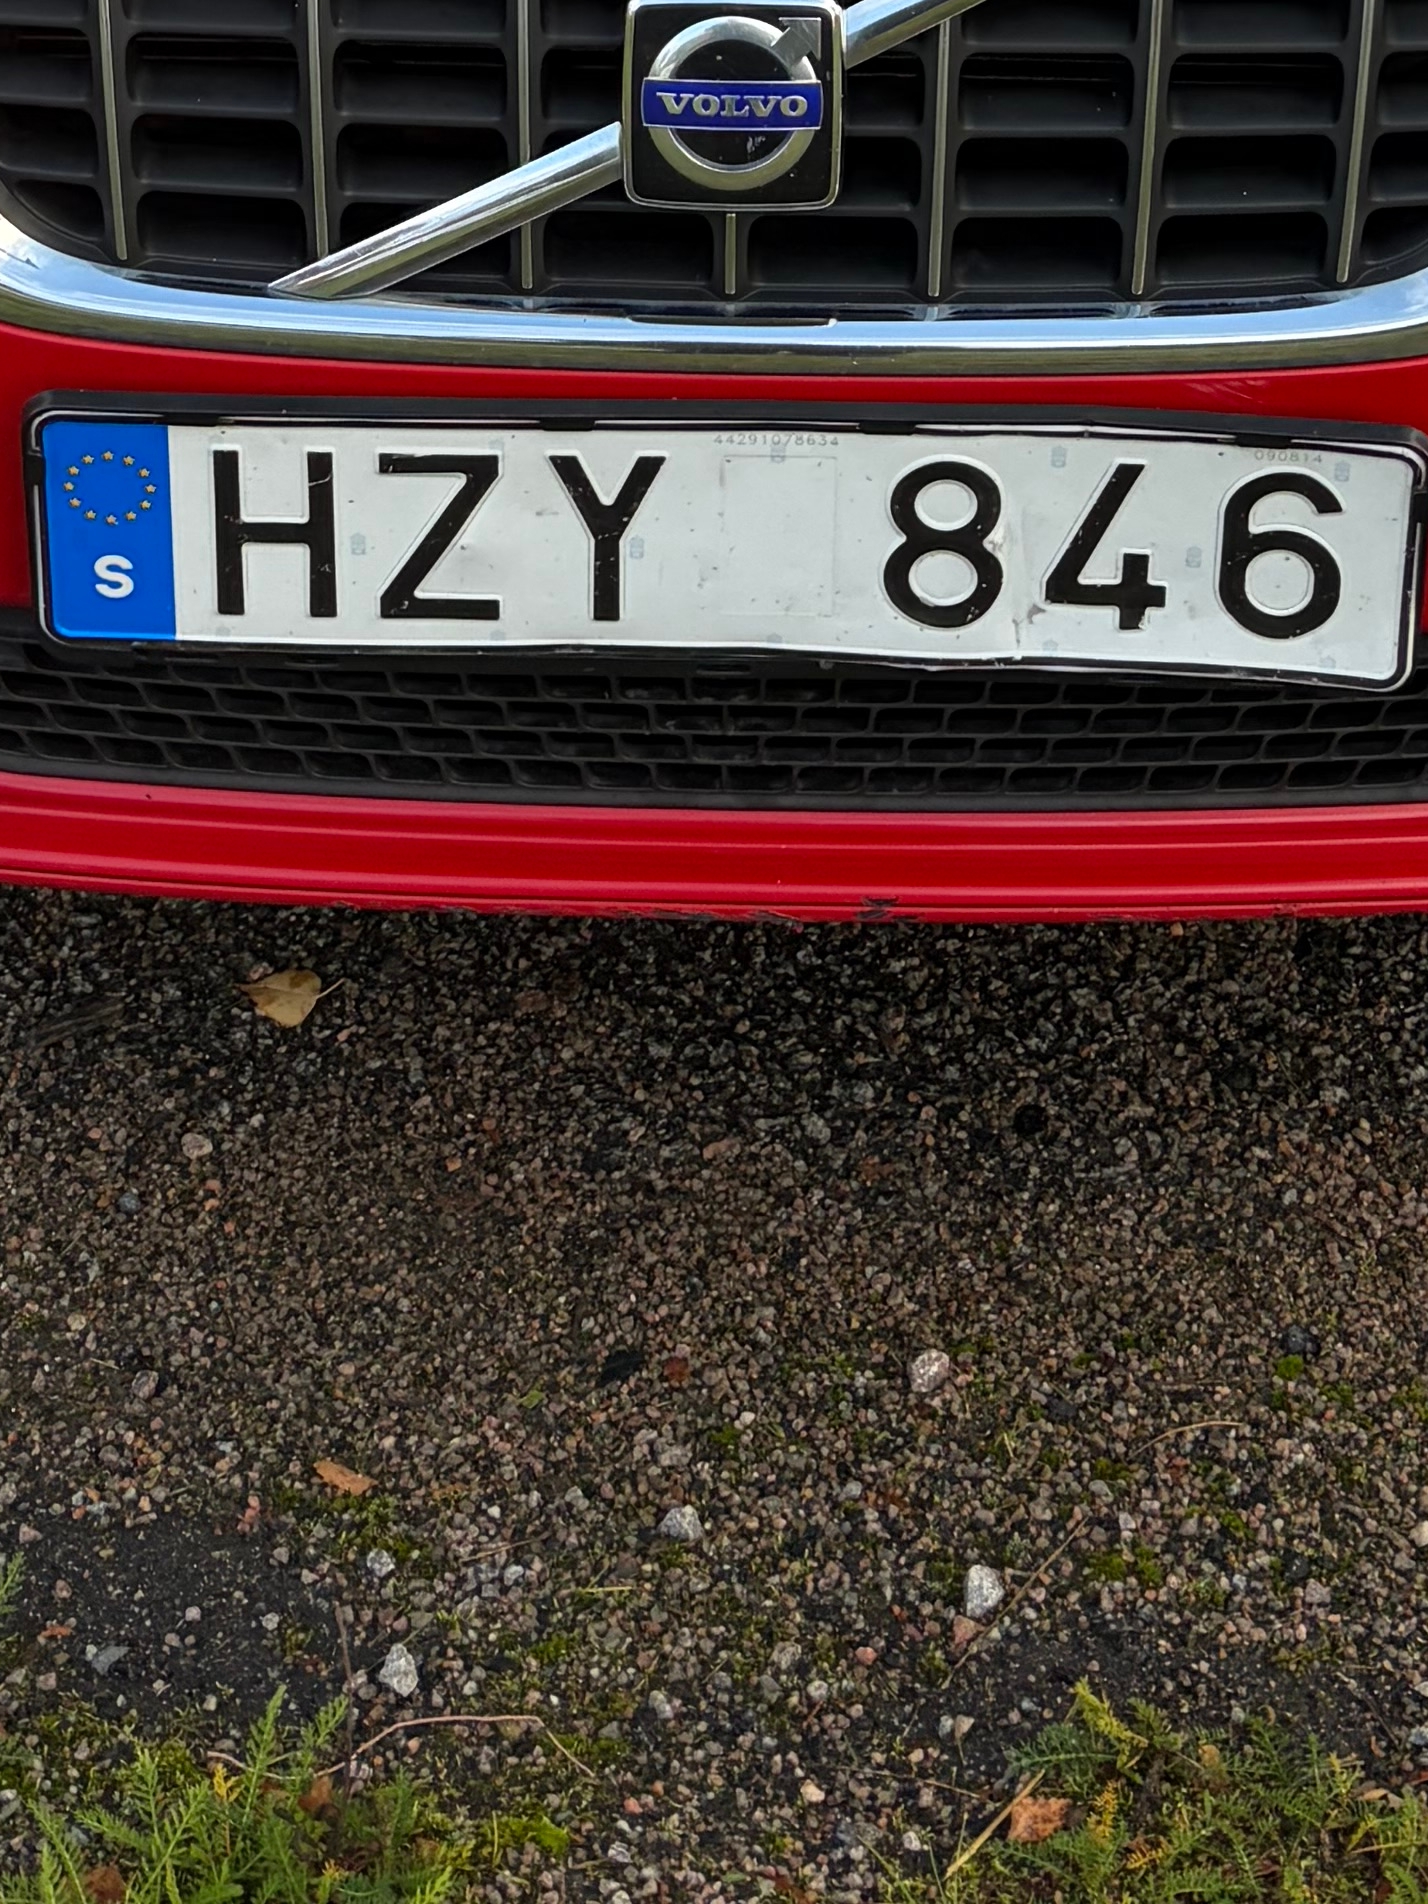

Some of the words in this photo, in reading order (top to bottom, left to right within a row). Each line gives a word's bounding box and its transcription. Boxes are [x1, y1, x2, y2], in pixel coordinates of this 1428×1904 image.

[656, 92, 809, 118] VOLVO
[1254, 449, 1323, 463] 090814
[212, 448, 668, 622] HZY
[881, 460, 1344, 640] 846
[93, 553, 135, 599] S
